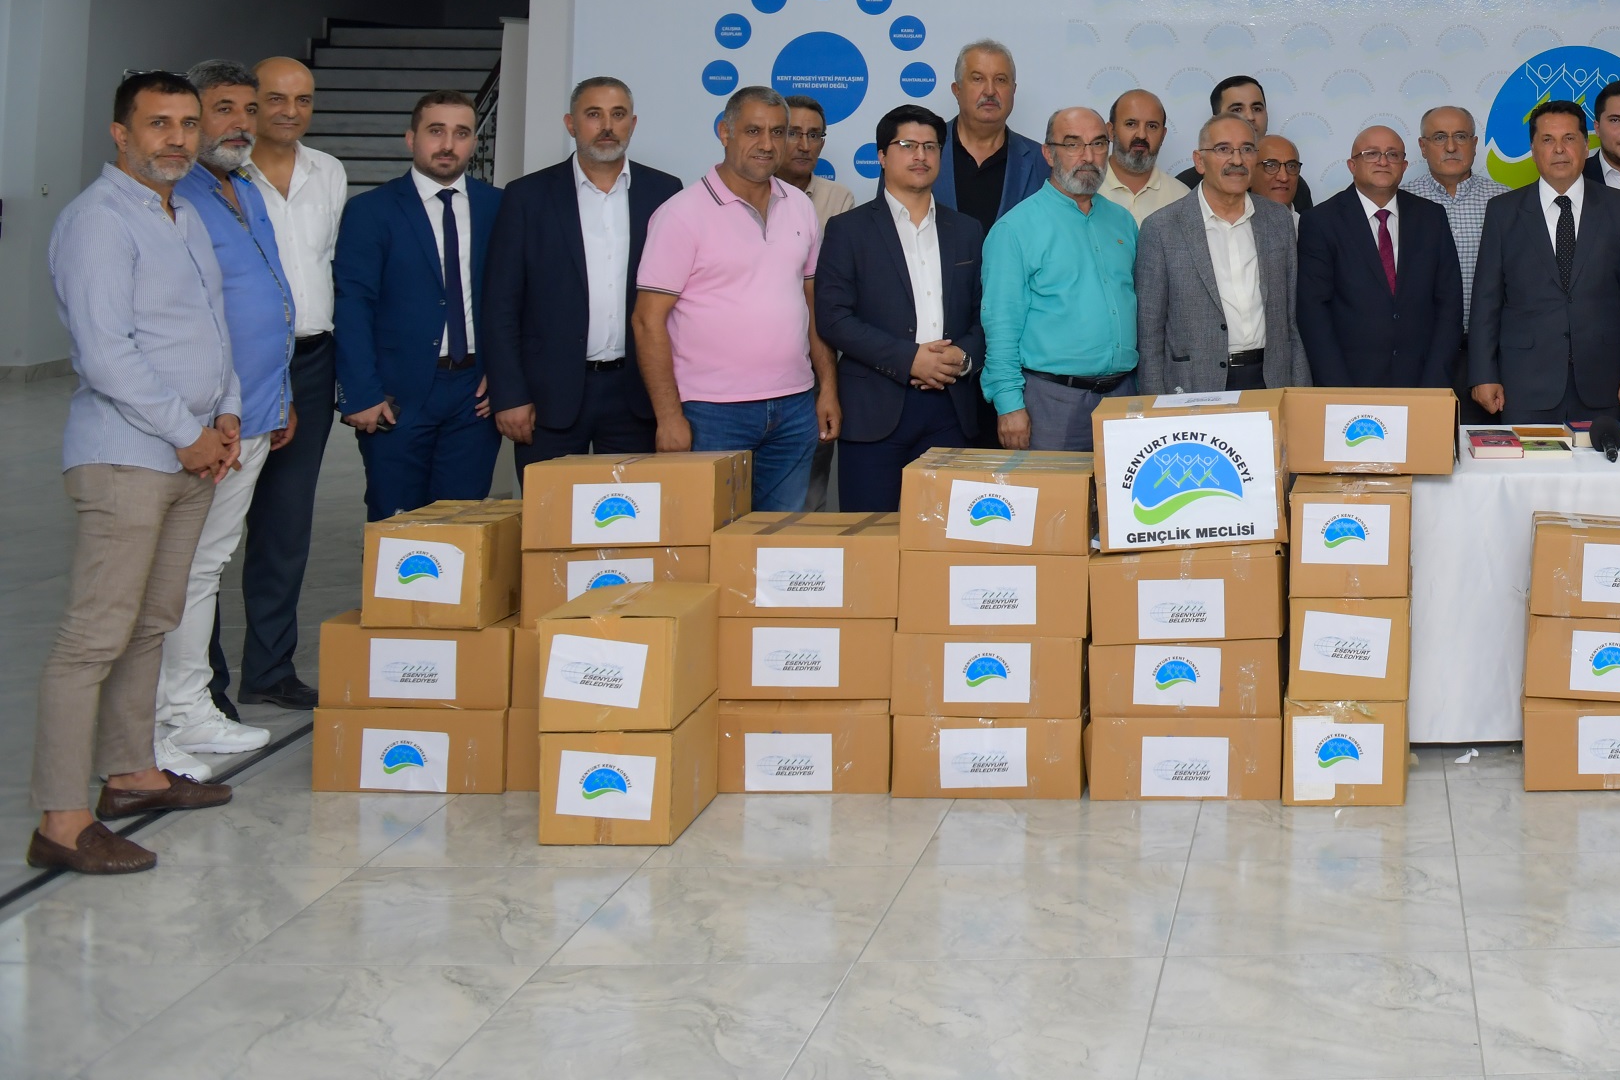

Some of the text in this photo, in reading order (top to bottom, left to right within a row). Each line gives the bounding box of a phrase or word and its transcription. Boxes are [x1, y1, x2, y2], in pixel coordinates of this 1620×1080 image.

[1122, 431, 1254, 490] ESENYURT KENT KONSEYİ
[1126, 522, 1255, 546] GENÇLİK MECLİSİ
